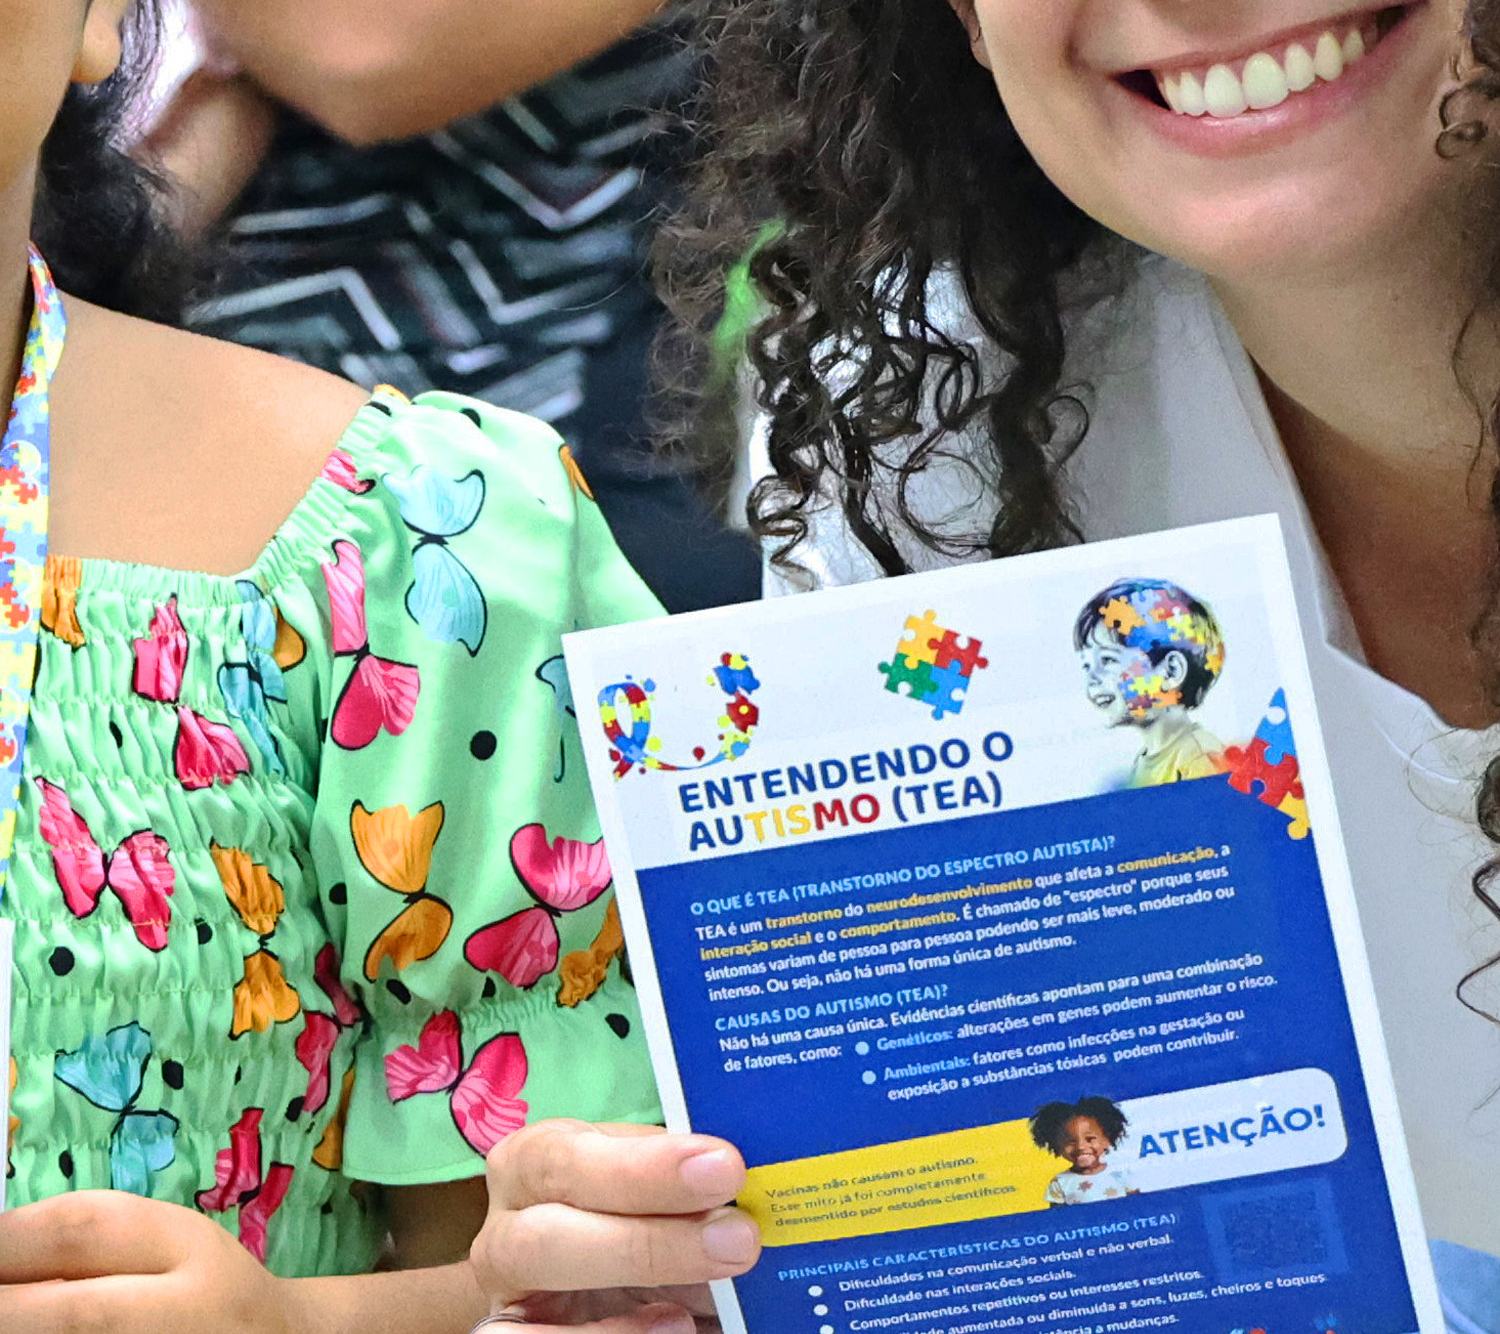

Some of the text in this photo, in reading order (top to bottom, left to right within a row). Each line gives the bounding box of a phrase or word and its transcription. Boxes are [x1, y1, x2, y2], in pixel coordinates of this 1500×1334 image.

[679, 731, 1013, 812] ENTENDENDO O
[689, 773, 1002, 851] AUTISMO (TEA)
[695, 845, 1230, 940] TEA é um transtorno do neurodesenvolvimento que afeta a comunicação, a
[708, 935, 1076, 1001] intenso. Ou seja, não há uma forma única de autismo.
[715, 984, 948, 1031] CAUSAS DO AUTISMO (TEA)?
[877, 975, 1277, 1050] Genéticos: alterações em genes podem aumentar o risco.
[1139, 1104, 1325, 1158] ATENÇÃO!
